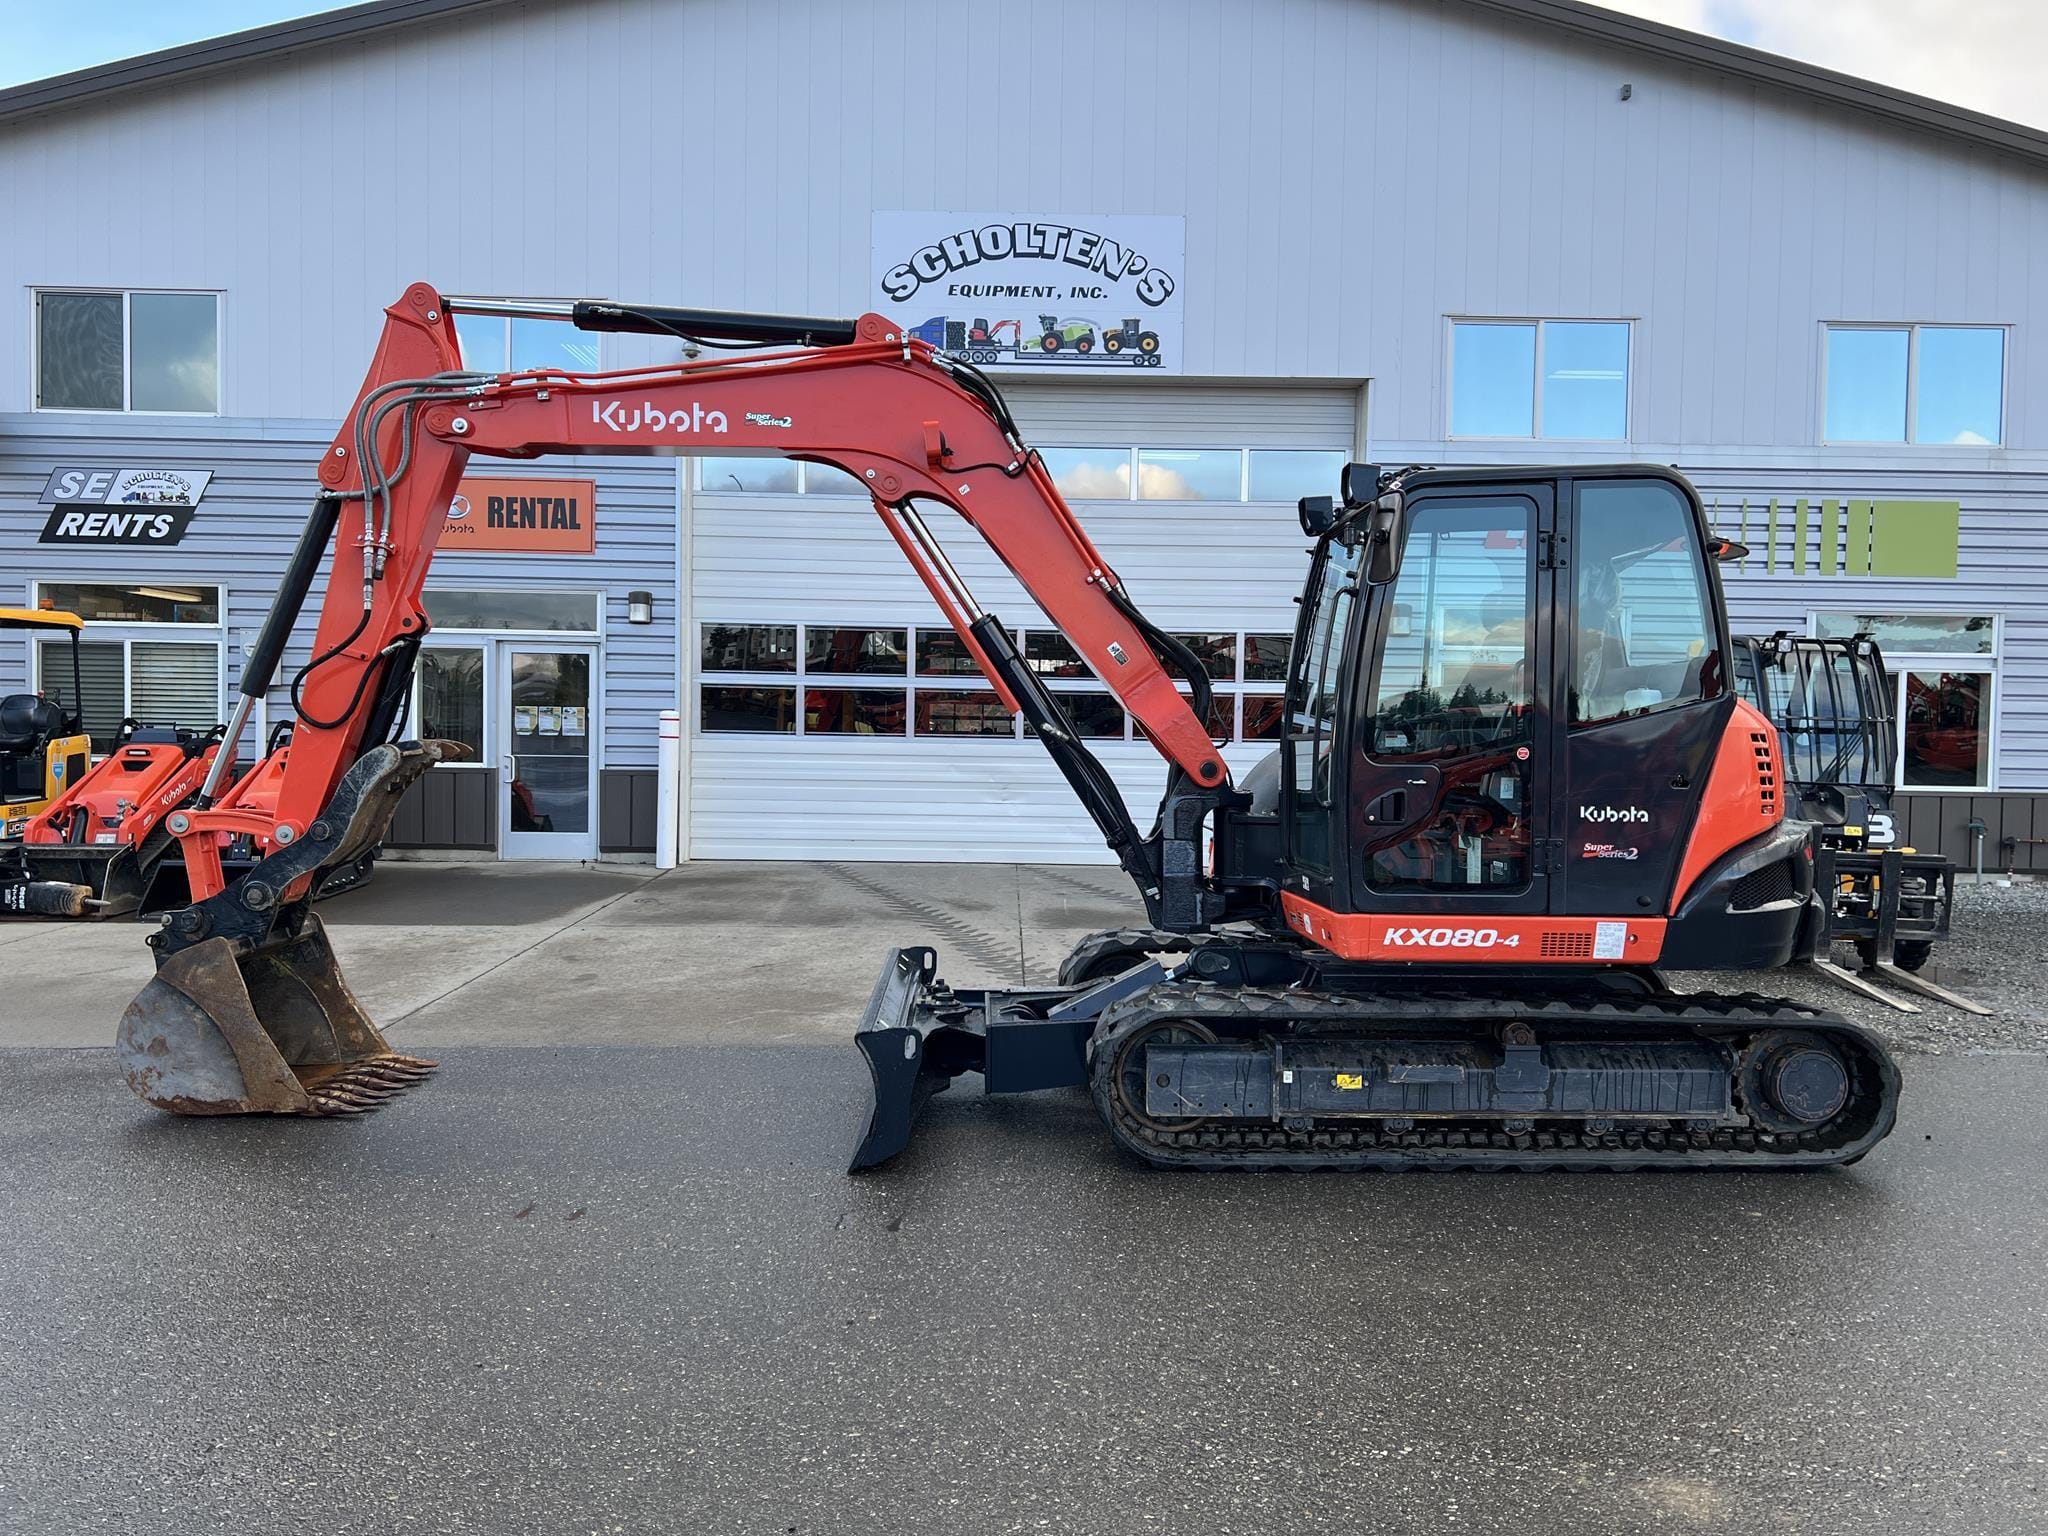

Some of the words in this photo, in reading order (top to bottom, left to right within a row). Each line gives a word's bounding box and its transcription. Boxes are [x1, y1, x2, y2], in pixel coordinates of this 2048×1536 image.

[881, 223, 1175, 307] SCHOLTEN'S
[948, 284, 1062, 301] EQUIPMENT,
[1070, 286, 1109, 300] INC.
[592, 400, 729, 433] Kubota
[745, 412, 772, 421] Super
[53, 471, 114, 500] SE
[121, 471, 192, 492] SCHOLTEN'S
[487, 496, 581, 530] RENTAL
[55, 512, 175, 539] RENTS
[441, 523, 475, 534] ubota
[161, 782, 187, 806] Kubota
[1580, 805, 1649, 823] Kubota
[1583, 842, 1615, 853] Super
[1383, 927, 1520, 948] KX080-4
